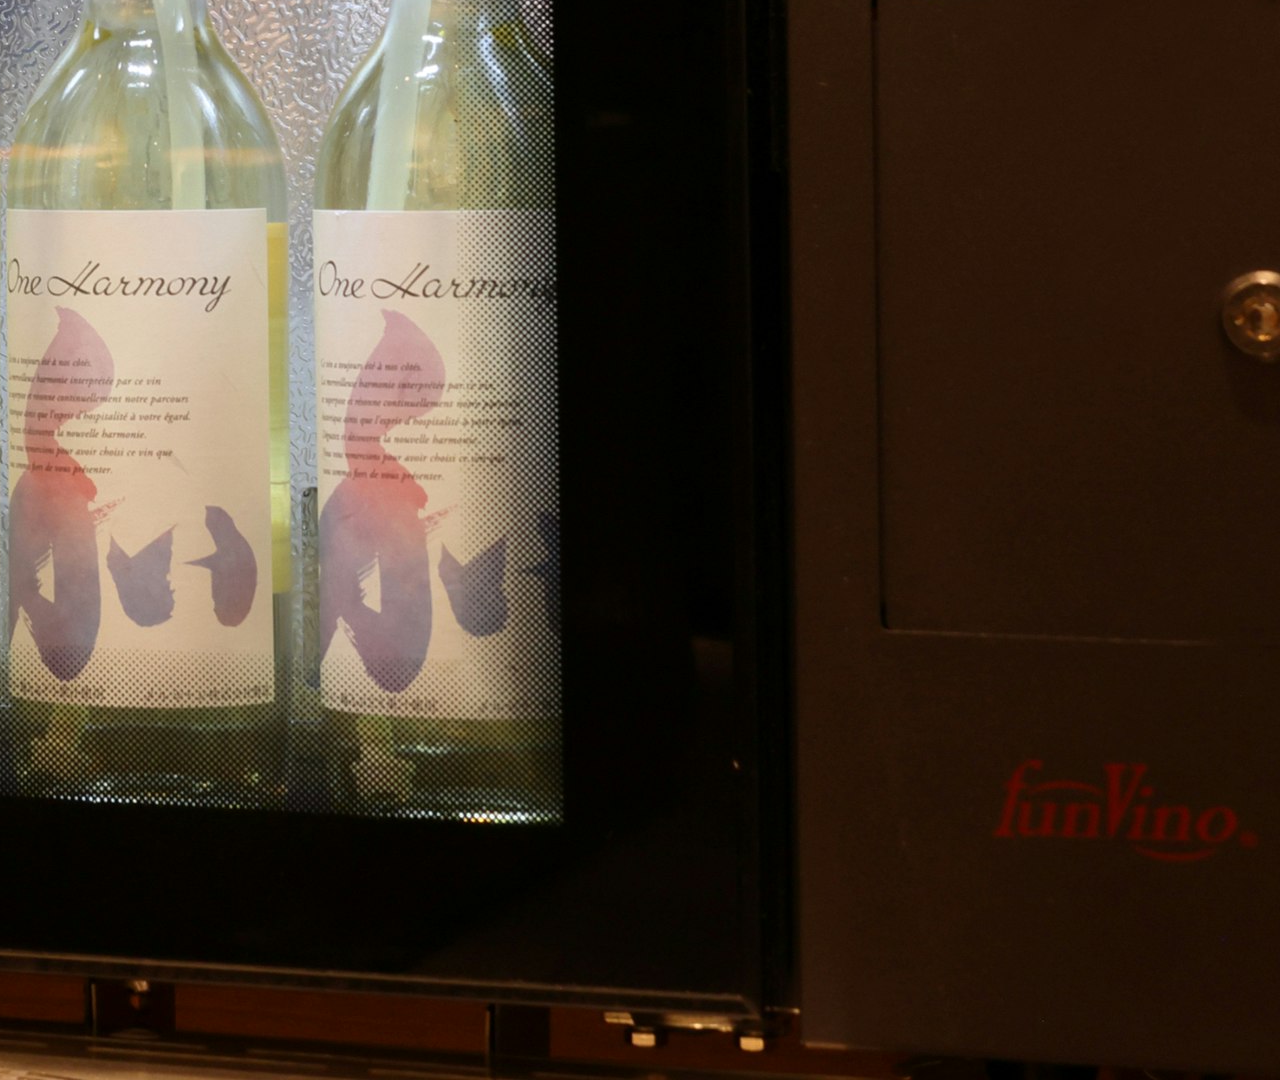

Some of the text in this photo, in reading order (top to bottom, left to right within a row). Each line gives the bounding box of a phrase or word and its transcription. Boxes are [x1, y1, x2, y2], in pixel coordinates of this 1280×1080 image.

[318, 260, 366, 298] One
[7, 258, 232, 313] One Harmony
[115, 378, 132, 388] par
[146, 377, 161, 385] vin
[125, 395, 147, 403] notre
[150, 396, 189, 406] parcours
[139, 413, 161, 421] votre
[101, 430, 147, 439] harmonie.
[75, 448, 96, 456] avoir
[126, 449, 136, 457] ce
[138, 448, 154, 457] vin
[155, 449, 174, 459] que
[404, 454, 427, 462] avoir
[994, 758, 1242, 846] funVino
